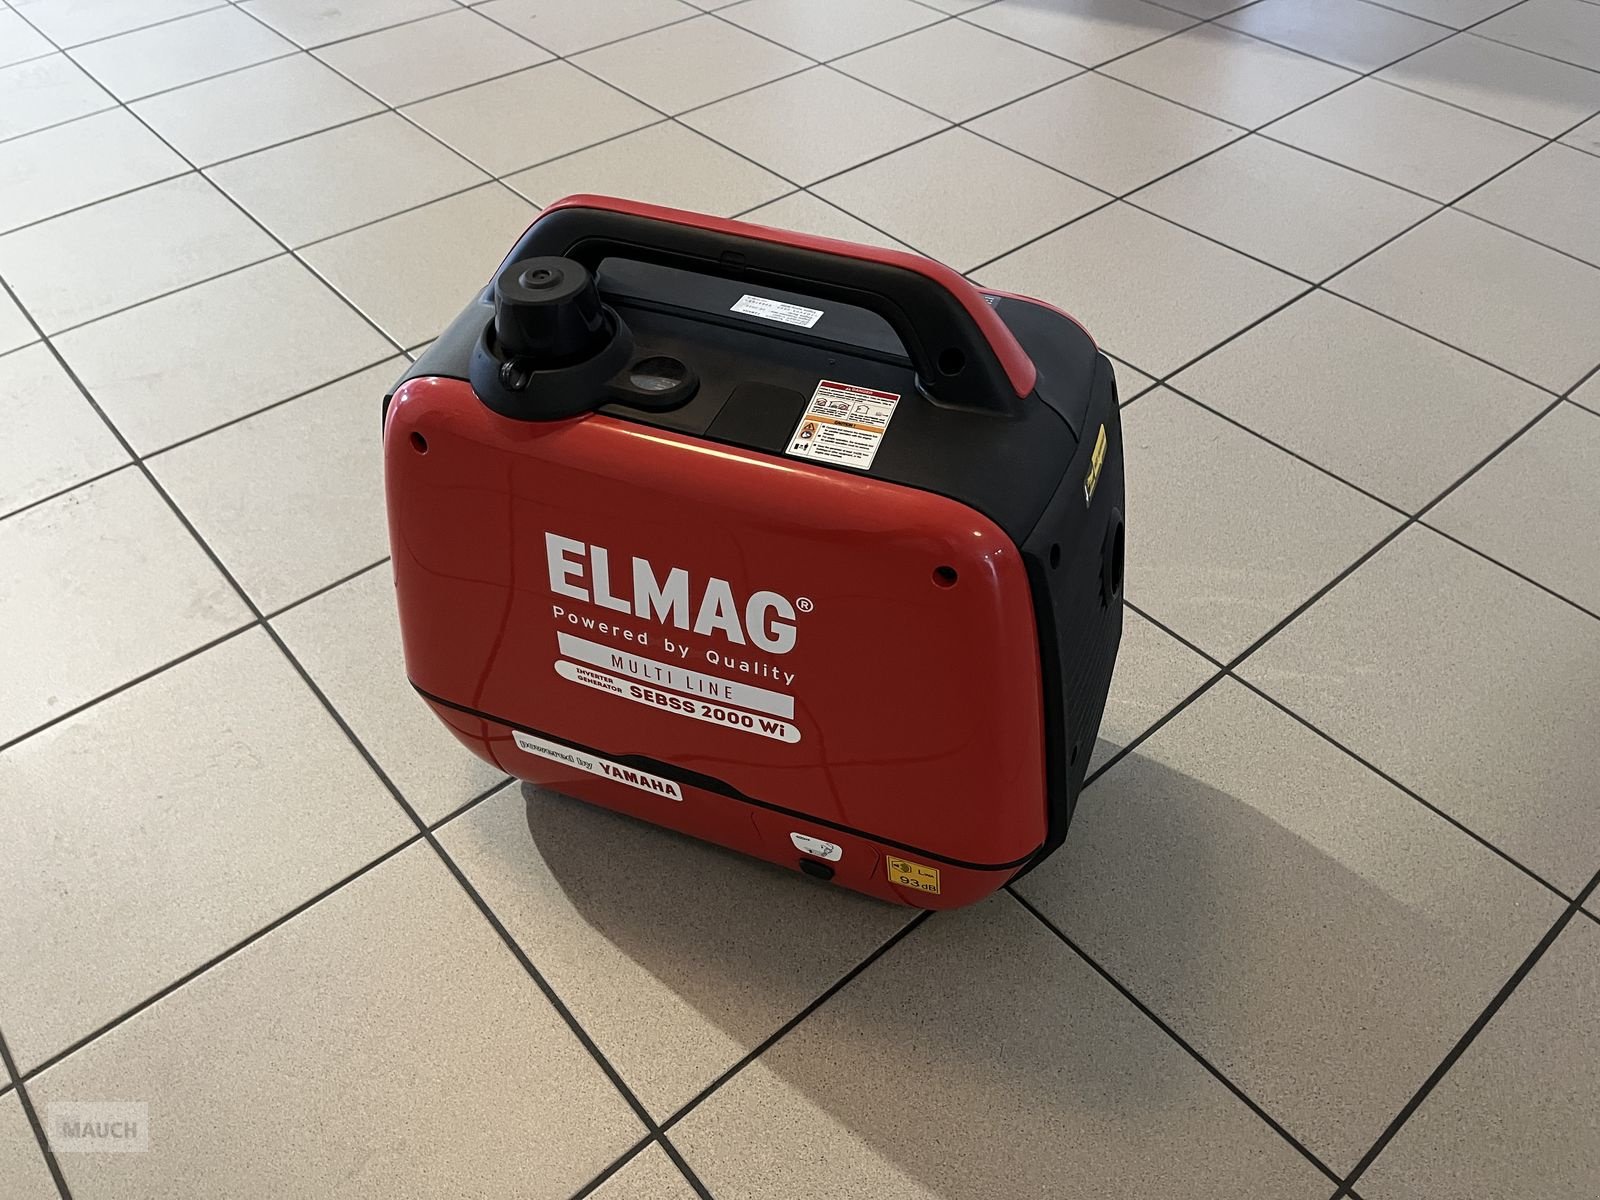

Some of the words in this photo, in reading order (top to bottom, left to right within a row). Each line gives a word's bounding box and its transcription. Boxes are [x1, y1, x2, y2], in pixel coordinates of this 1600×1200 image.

[553, 605, 648, 645] Powered
[664, 638, 689, 659] by
[705, 650, 795, 686] Quality
[576, 667, 614, 684] INVERTER
[577, 675, 623, 694] GENERATOR
[611, 654, 671, 684] MULTI
[686, 675, 733, 700] LINE
[629, 685, 696, 714] SEBSS
[701, 705, 754, 728] 2000
[758, 718, 785, 737] Wi
[519, 740, 575, 763] powered
[576, 756, 593, 770] by
[599, 761, 677, 797] YAMAHA
